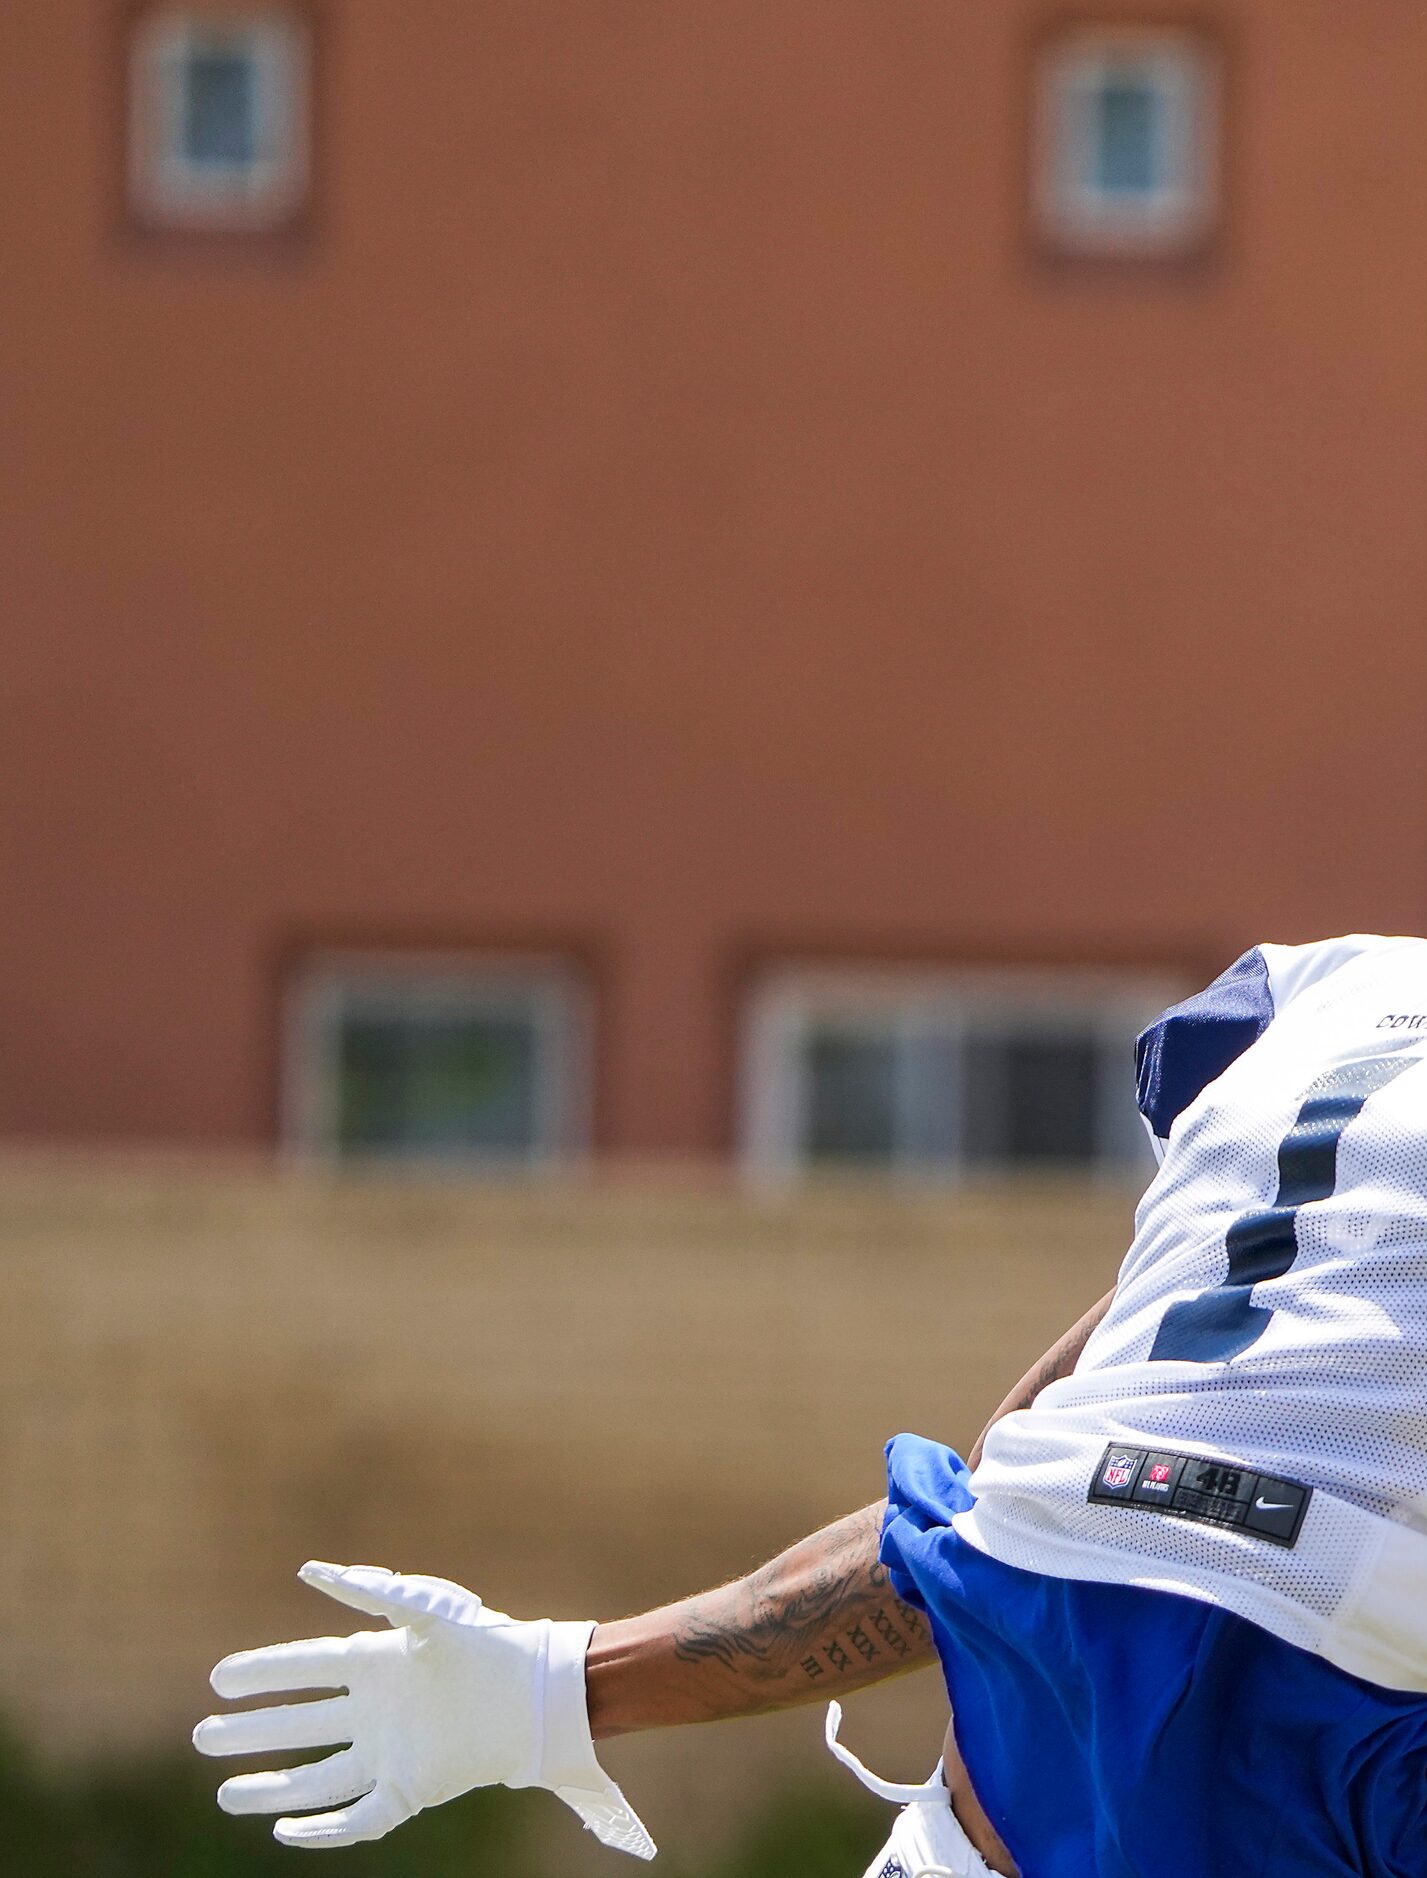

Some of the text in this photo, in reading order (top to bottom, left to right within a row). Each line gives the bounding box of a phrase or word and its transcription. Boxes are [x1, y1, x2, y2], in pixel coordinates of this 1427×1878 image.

[1148, 1056, 1424, 1363] 1
[1107, 1467, 1127, 1484] NFL
[847, 1625, 880, 1663] XIX
[870, 1609, 912, 1657] XXIX
[800, 1656, 823, 1679] III
[822, 1641, 851, 1672] XX
